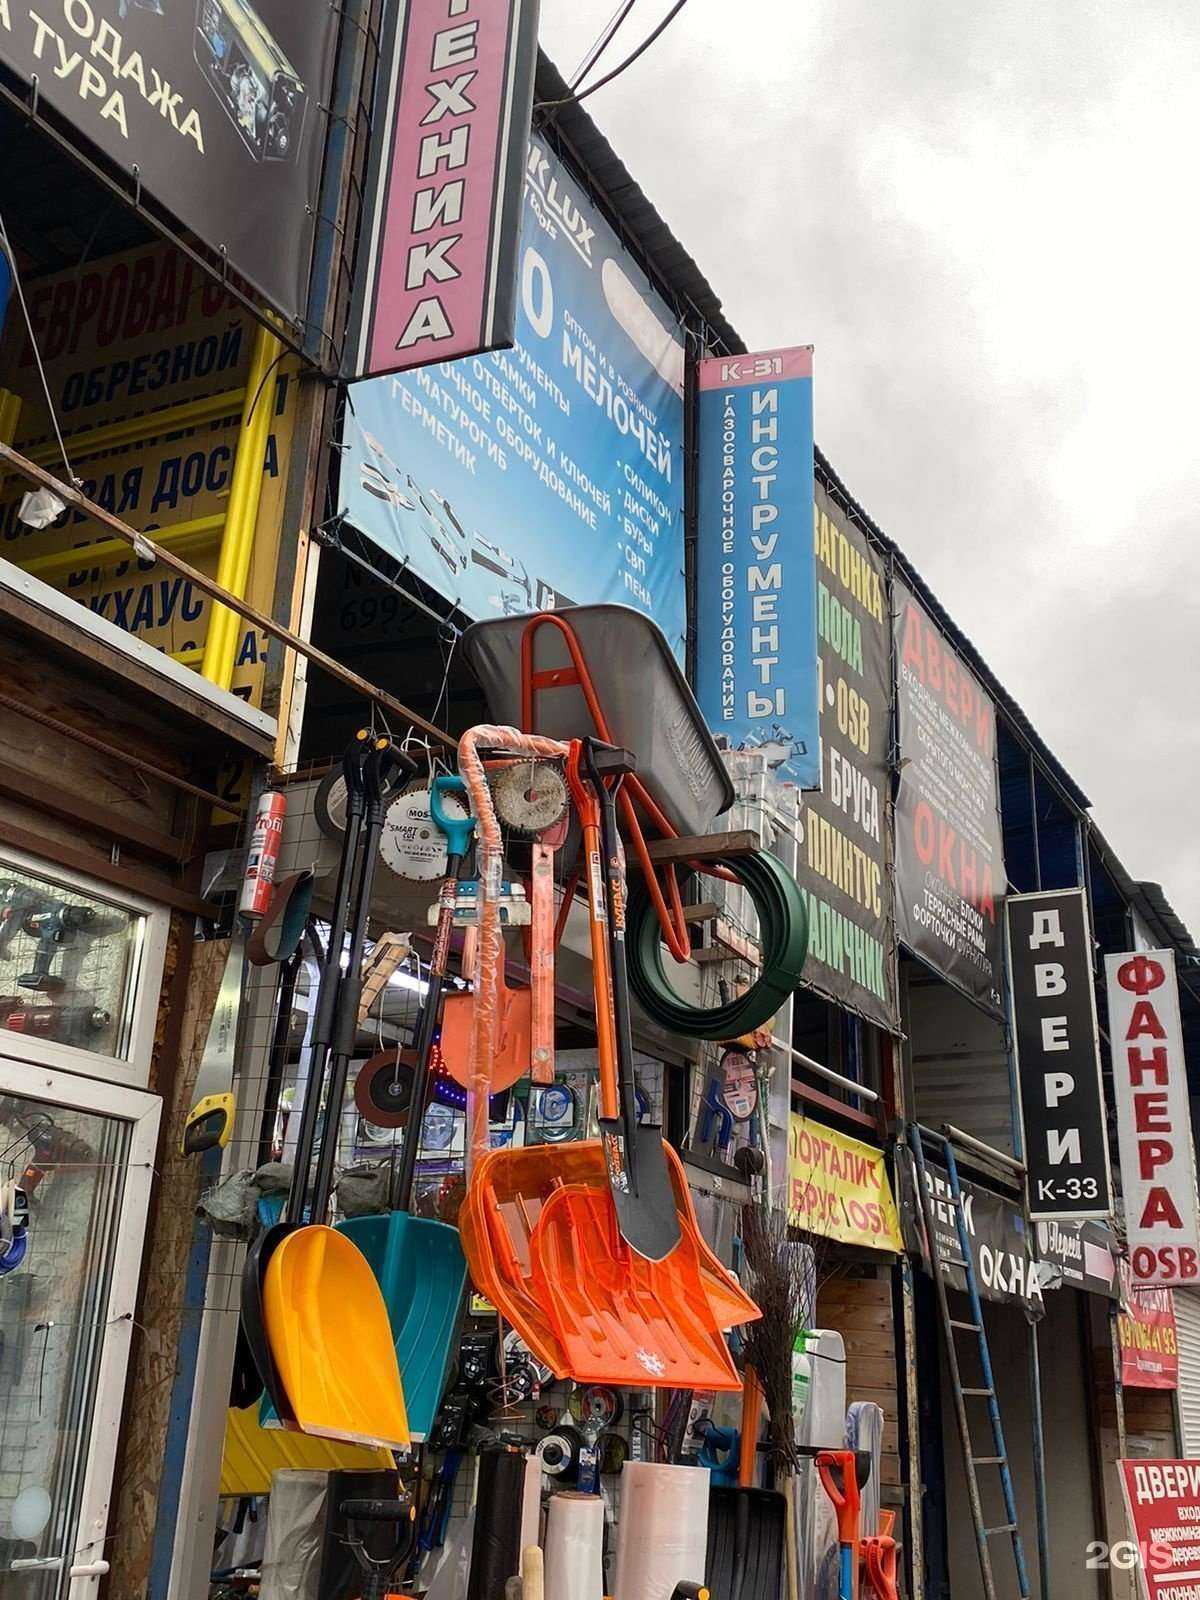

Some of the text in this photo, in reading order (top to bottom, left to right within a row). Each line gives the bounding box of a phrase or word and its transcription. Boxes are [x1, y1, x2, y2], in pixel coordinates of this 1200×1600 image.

[62, 322, 244, 413] ОБРЕЗНОЙ
[564, 309, 597, 358] ОПТОМ
[599, 351, 609, 370] И
[720, 357, 784, 382] К-31
[391, 377, 478, 475] ГЕРМЕТИК
[406, 368, 509, 472] МАТУРОГИБ
[472, 358, 612, 516] ОТВЁРТОК И КЛЮЧЕЙ
[562, 328, 672, 485] МЕЛОЧЕЙ
[150, 434, 280, 514] ДОСА
[495, 415, 599, 531] ОБОРУДОВАНИЕ
[623, 491, 660, 537] ДИСКИ
[624, 463, 672, 526] СИЛИКОН
[623, 517, 653, 558] БУРЫ
[624, 545, 646, 577] СВП
[721, 394, 736, 721] ГАЗОСВАРОЧНОЕ ОБОРУДОВАНИЕ
[747, 388, 786, 719] ИНСТРУМЕНТЫ
[624, 570, 653, 611] ПЕНА
[817, 580, 864, 678] ПОЛА
[837, 676, 870, 755] OSB
[902, 603, 992, 758] ДВЕРИ
[830, 746, 881, 844] БРУСА
[807, 806, 882, 920] ПЛИНТУС
[913, 799, 996, 929] ОКНА
[913, 903, 957, 950] ФОРТОЧКИ
[923, 888, 987, 954] ТЕРРАСНЫЕ РАМЫ
[1029, 909, 1082, 1167] ДВЕРИ
[1116, 955, 1184, 1229] ФАНЕРА
[1037, 1177, 1099, 1201] К-33
[979, 1243, 1044, 1302] ОКНА
[1131, 1246, 1198, 1280] OSB
